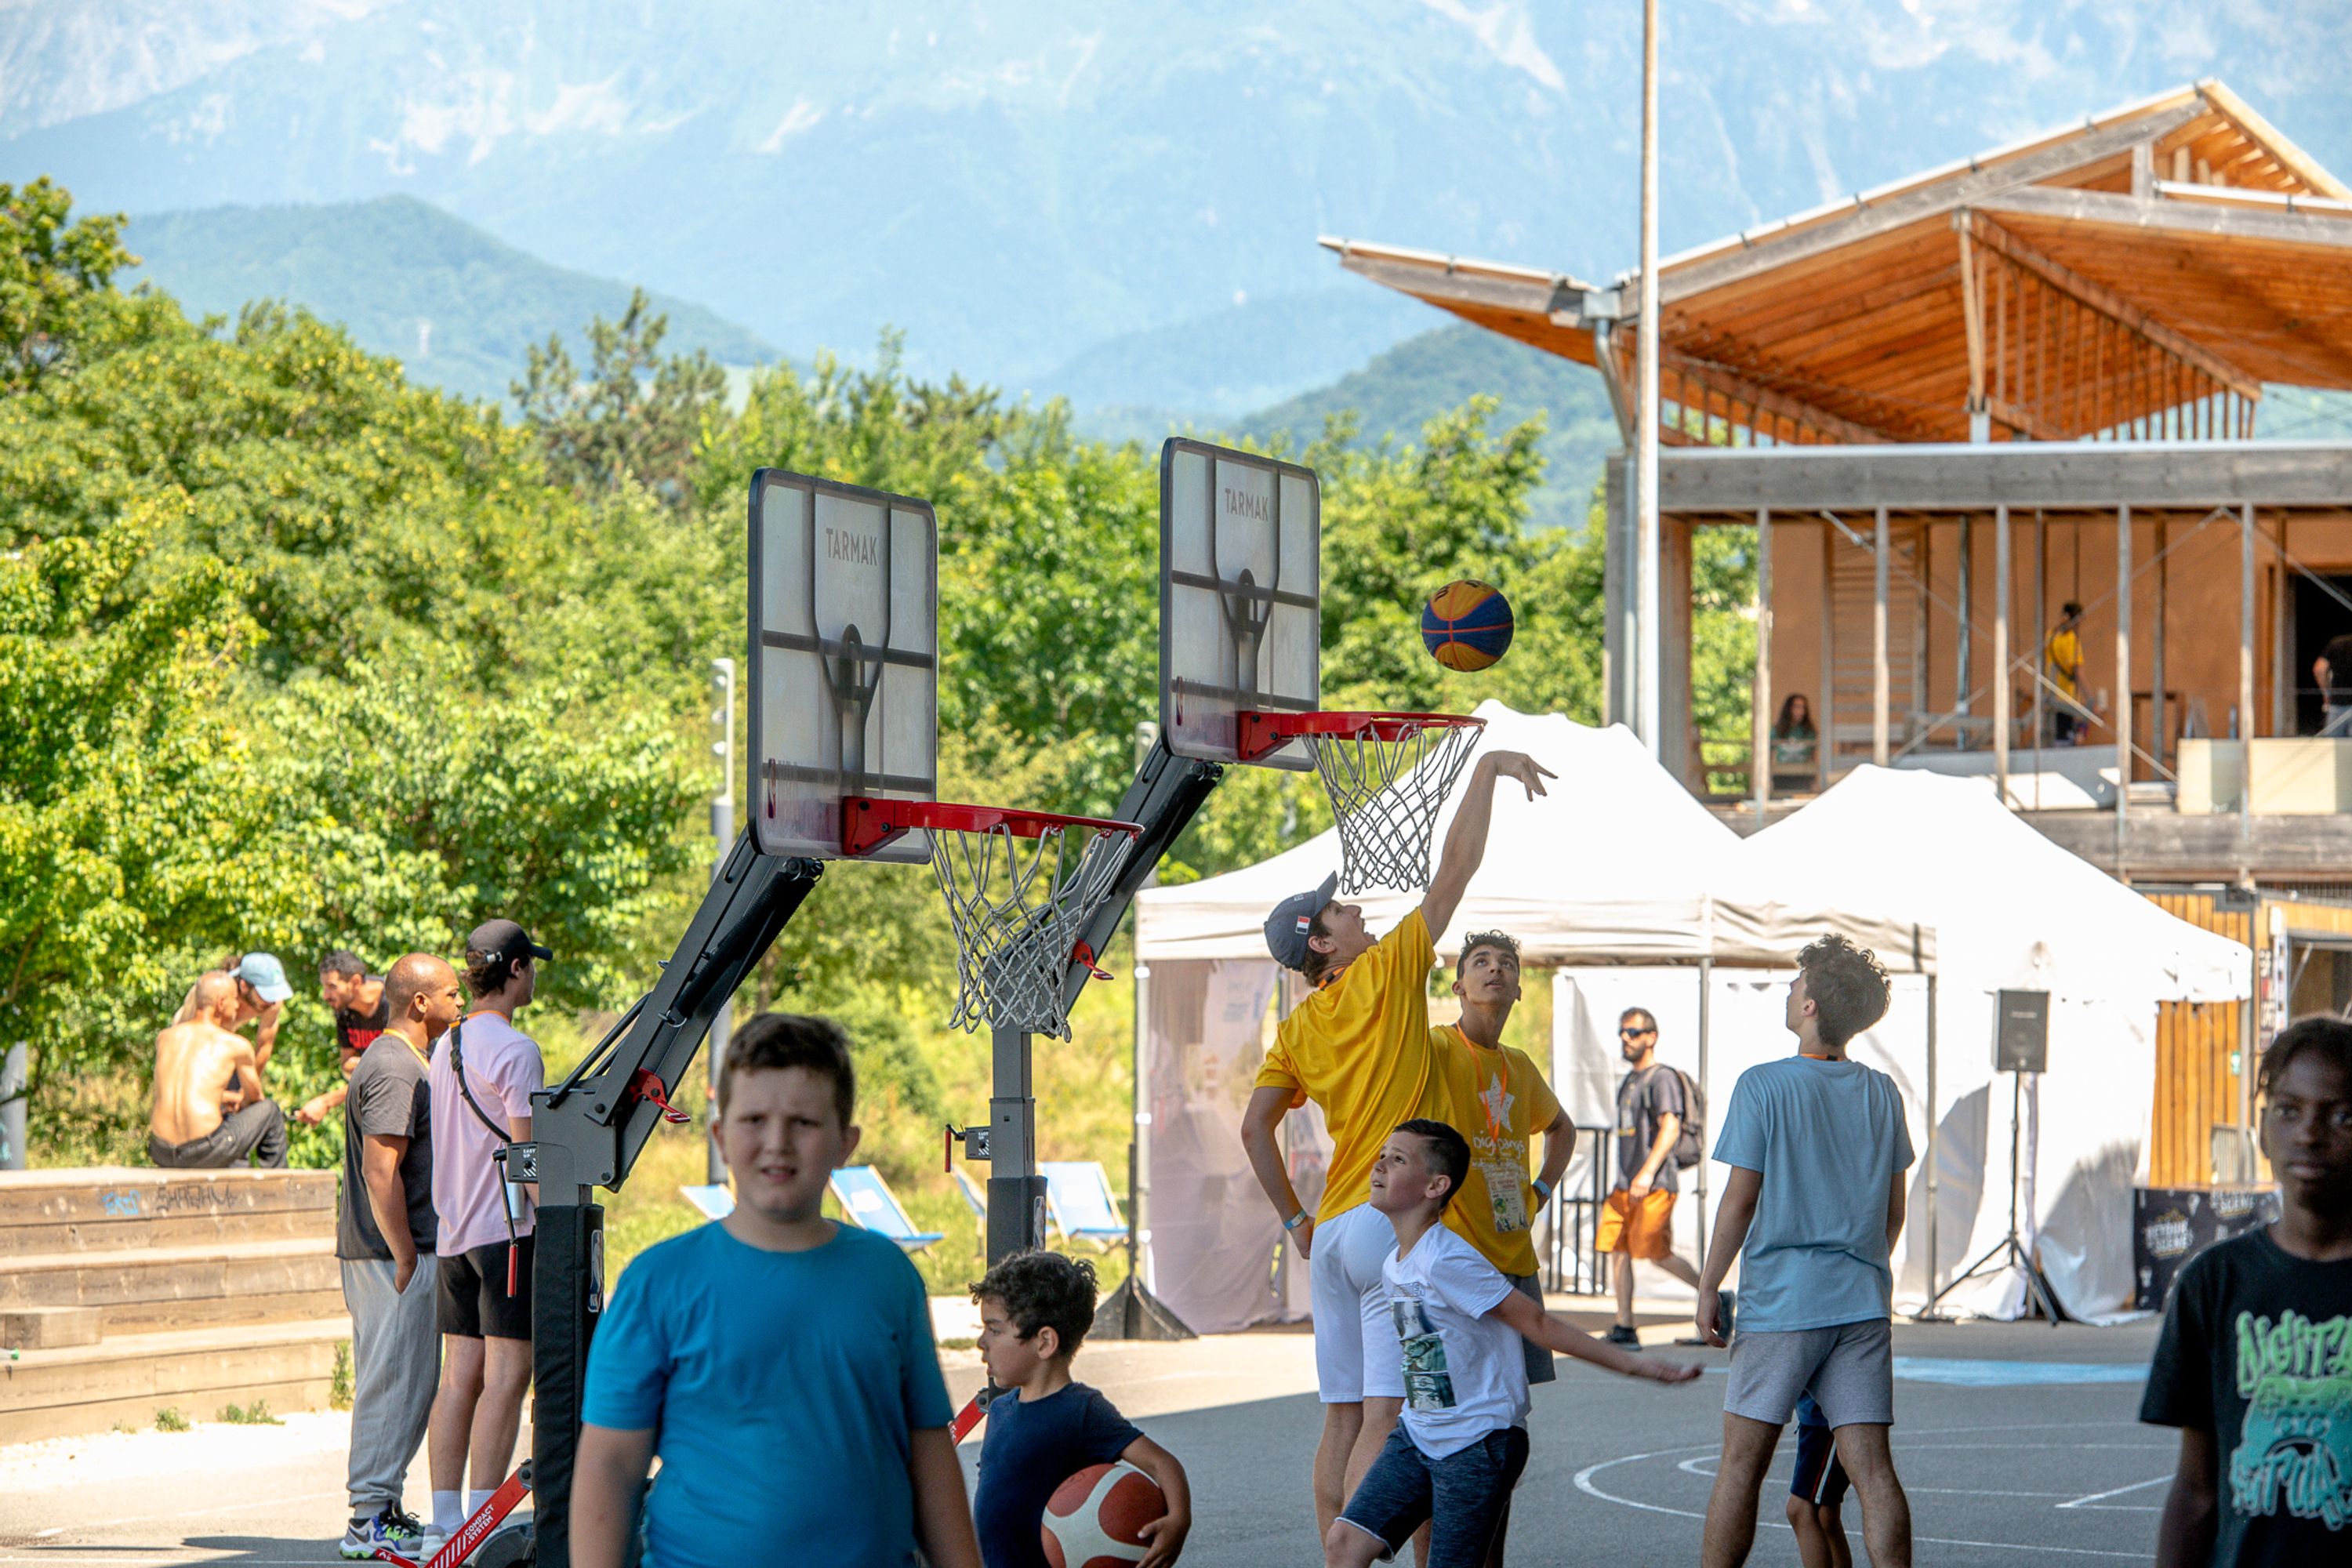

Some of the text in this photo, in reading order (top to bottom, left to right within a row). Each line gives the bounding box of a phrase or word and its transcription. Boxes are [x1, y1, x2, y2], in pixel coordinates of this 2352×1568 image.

[1225, 488, 1269, 522] TARMAK
[826, 528, 878, 567] TARMAK
[464, 1504, 494, 1536] COMPACT
[468, 1515, 494, 1544] SYSTEM
